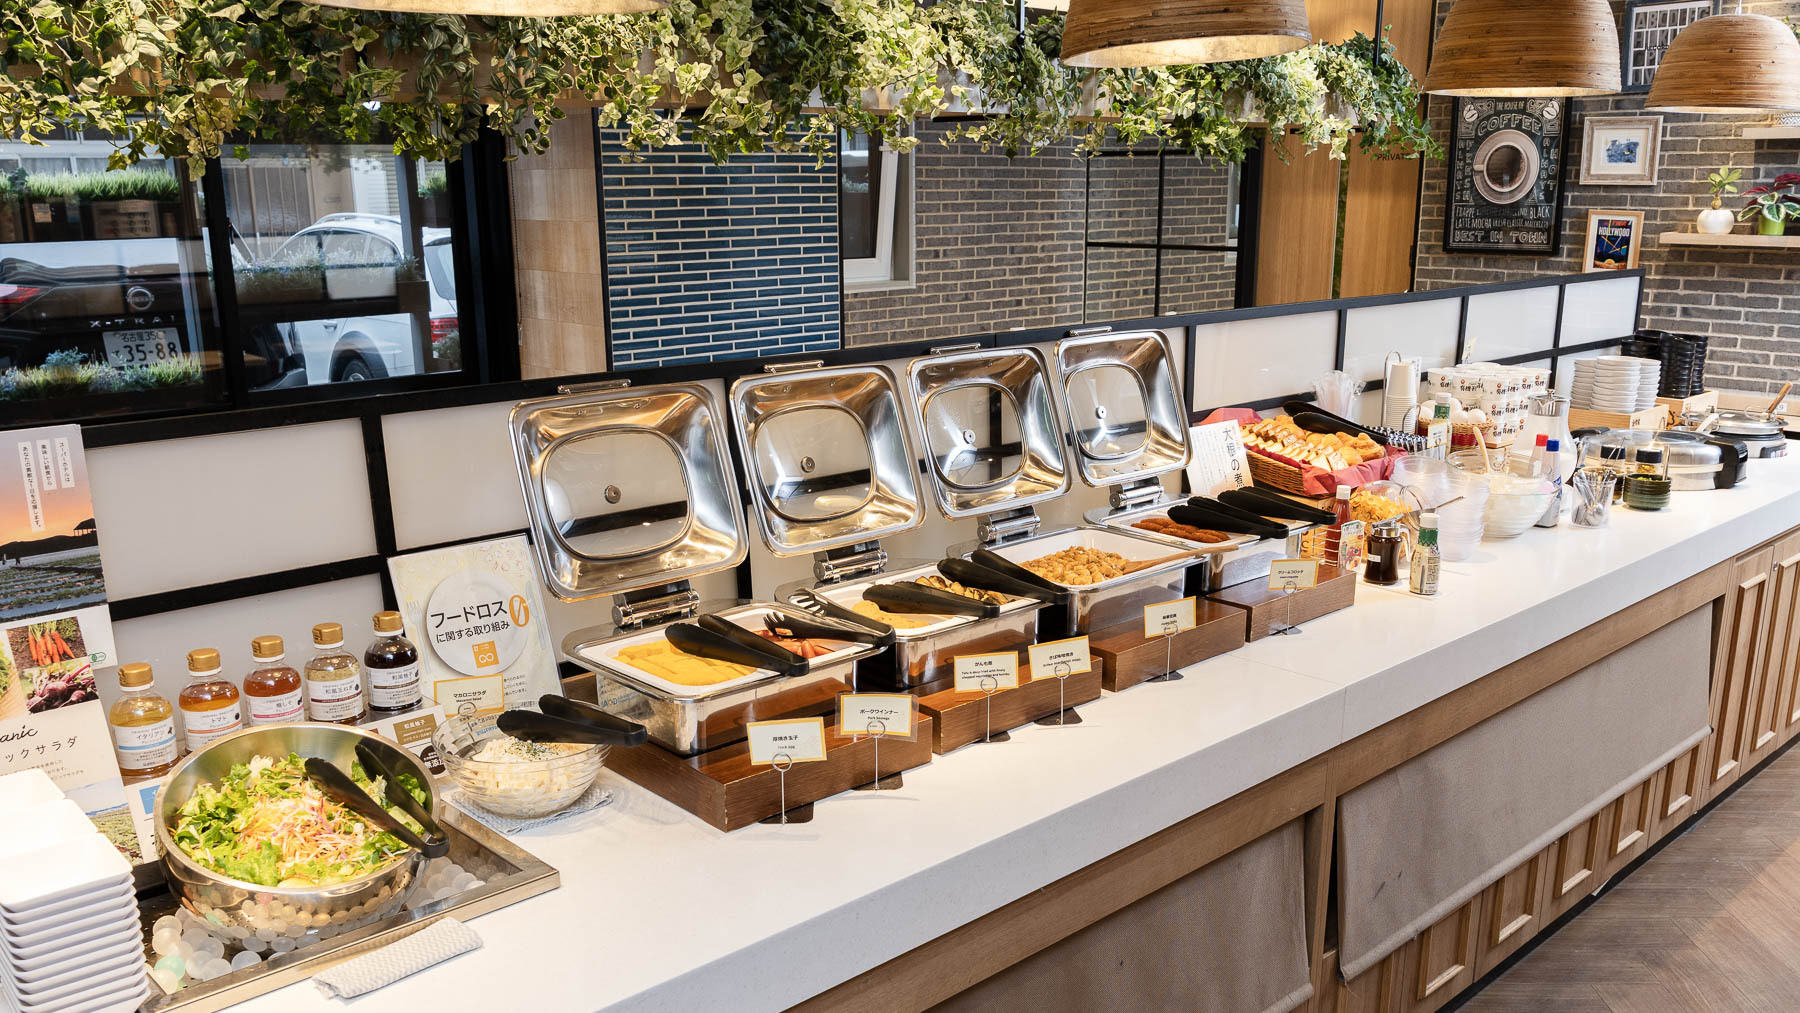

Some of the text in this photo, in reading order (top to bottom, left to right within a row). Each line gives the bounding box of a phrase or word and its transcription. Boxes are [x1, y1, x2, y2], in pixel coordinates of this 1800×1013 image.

[1477, 113, 1541, 136] COFFEE
[1529, 205, 1550, 219] BLACK
[1454, 230, 1548, 244] BEST IN TOWN
[1598, 226, 1630, 237] HOLLYWOOD
[436, 620, 511, 644] に関する取り組み
[453, 689, 487, 699] マカロニサラダ
[137, 729, 165, 740] イタリアン
[5, 735, 78, 763] ックサラダ
